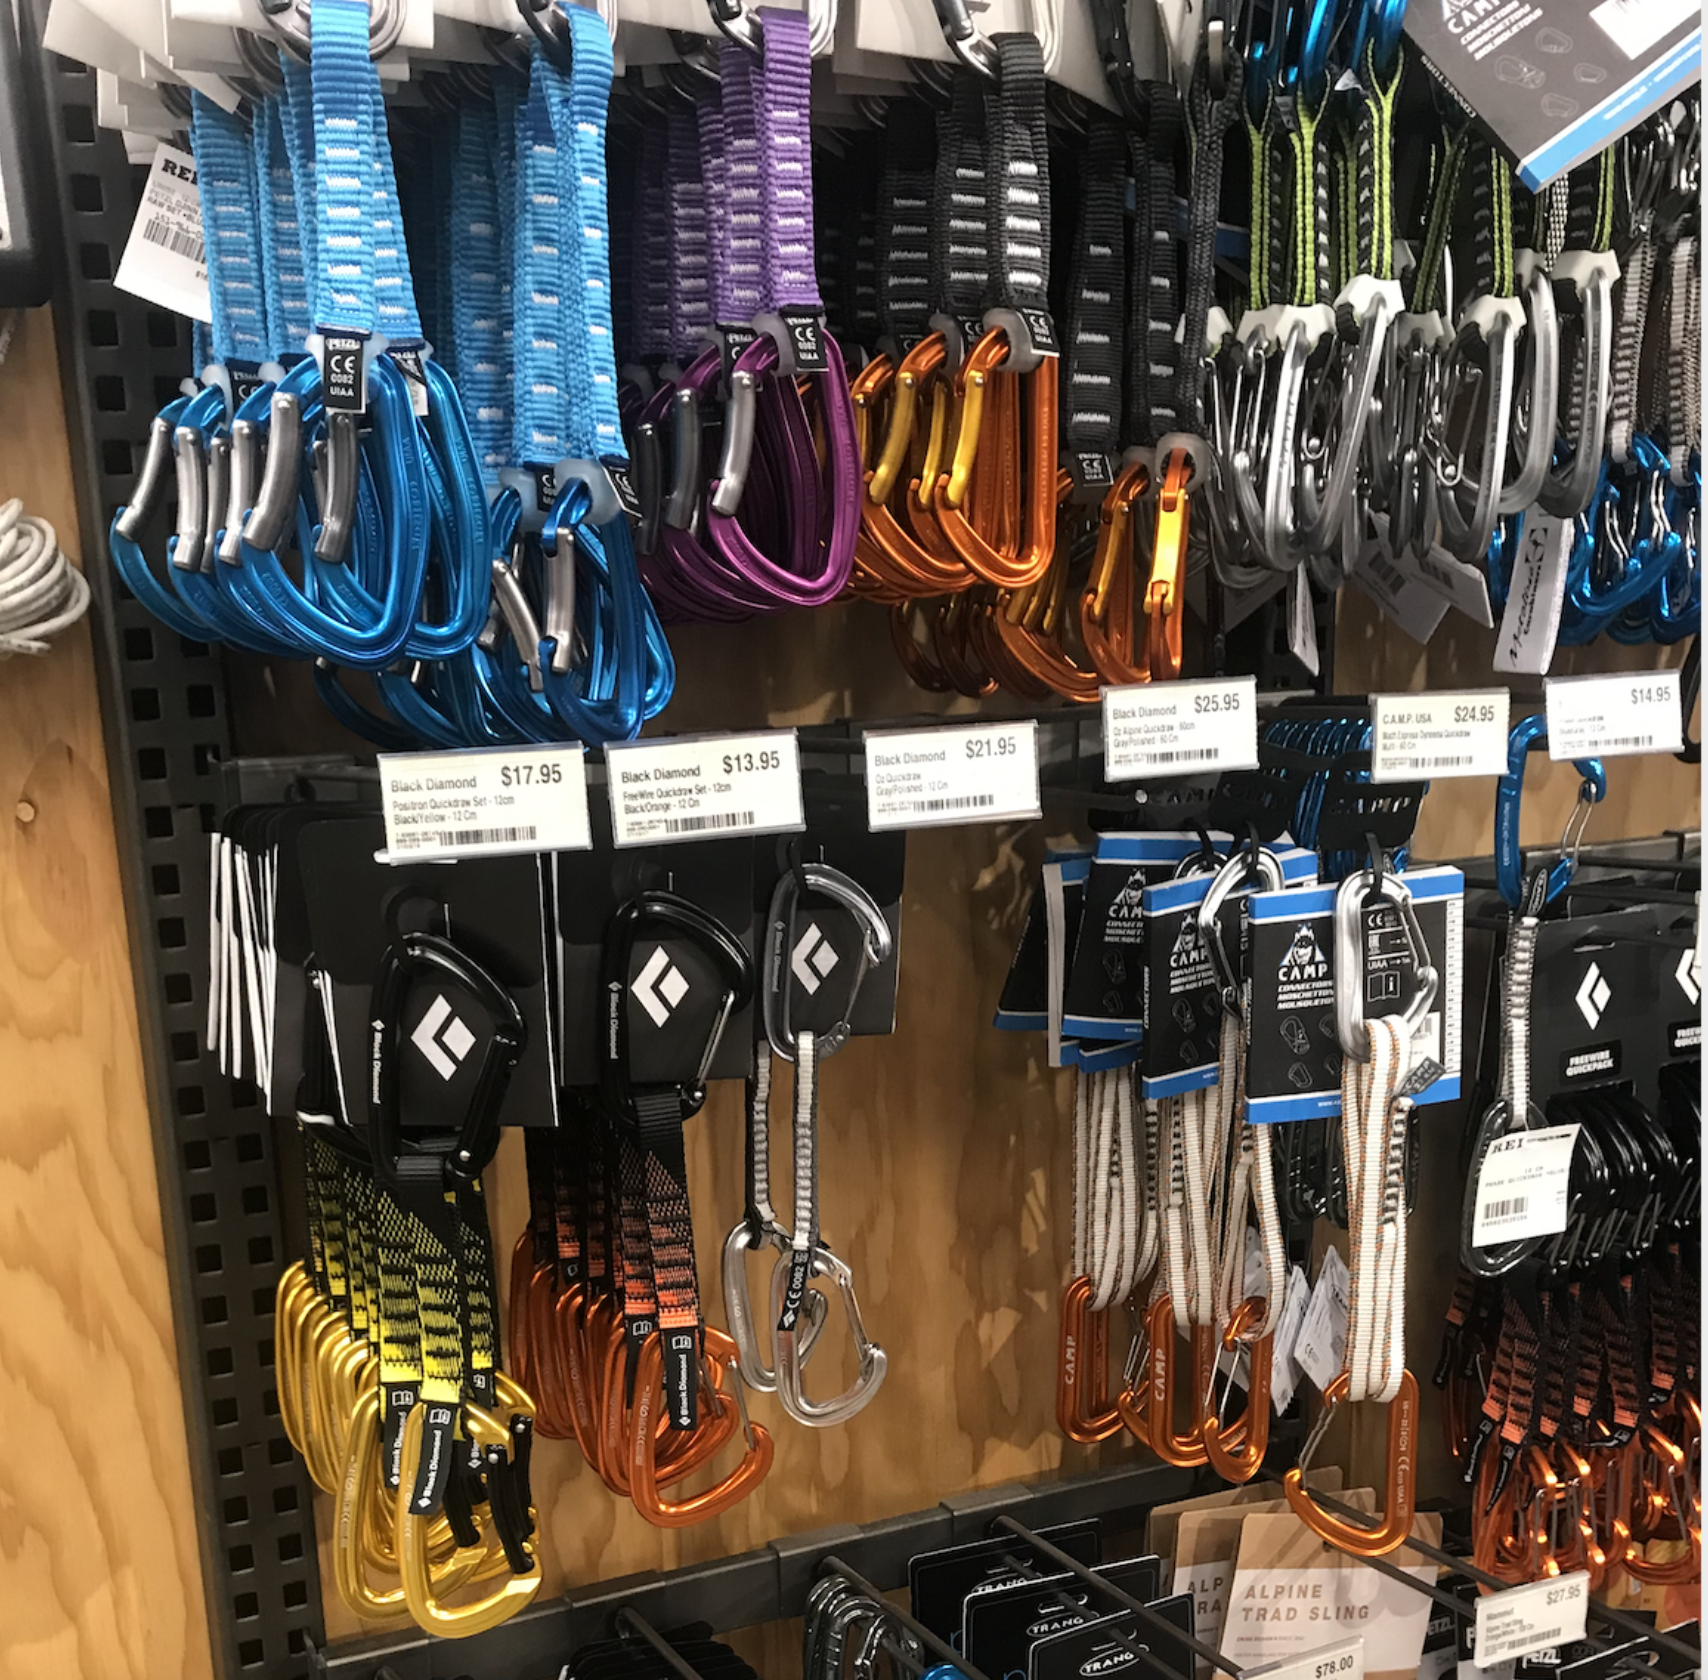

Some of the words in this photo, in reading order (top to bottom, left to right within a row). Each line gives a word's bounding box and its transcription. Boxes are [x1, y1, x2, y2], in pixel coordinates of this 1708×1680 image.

[330, 373, 354, 385] 0082
[329, 385, 354, 397] UIAA
[1631, 685, 1671, 705] $14.95
[1113, 707, 1136, 720] Black
[1138, 704, 1177, 718] Diamond
[1194, 692, 1240, 714] $25.95
[1415, 713, 1433, 724] USA
[1454, 705, 1495, 723] $24.95
[1144, 722, 1174, 734] Quickdraw
[1444, 729, 1471, 739] Quickdraw
[875, 755, 901, 767] Black
[903, 750, 946, 765] Diamond
[966, 736, 1016, 760] $21.95
[621, 770, 651, 784] Black
[654, 765, 701, 781] Diamond
[722, 750, 780, 775] $13.95
[391, 779, 424, 793] Black
[426, 776, 477, 791] Diamond
[501, 763, 562, 788] $17.95
[886, 771, 921, 784] Quickdraw
[623, 789, 654, 802] FreeWire
[656, 786, 693, 799] Quickdraw
[694, 783, 707, 795] Set
[713, 782, 732, 793] 12cm
[876, 784, 923, 798] Gray/Polished
[928, 781, 936, 792] 12
[393, 799, 428, 811] Positron
[430, 797, 471, 810] Quickdraw
[473, 796, 487, 807] Set
[494, 794, 515, 805] 12cm
[624, 802, 671, 815] Black/Orange
[678, 799, 687, 809] 12
[394, 811, 446, 825] Black/Yellow
[453, 811, 462, 822] 12
[464, 810, 477, 821] Cm
[1368, 913, 1382, 927] CE
[773, 931, 783, 955] Black
[1278, 963, 1328, 981] CAMP
[1368, 959, 1388, 970] UIAA
[610, 992, 619, 1018] Black
[373, 1031, 383, 1059] Black
[610, 1018, 619, 1060] Diamond
[1565, 1058, 1614, 1077] QUICKPACK
[1569, 1049, 1611, 1066] FREEWIRE
[372, 1060, 382, 1104] Diamond
[1491, 1137, 1525, 1155] REI
[792, 1266, 804, 1289] 0082
[786, 1291, 802, 1308] CE
[1065, 1335, 1076, 1385] CAMP
[678, 1354, 688, 1391] Diamond
[1154, 1348, 1166, 1401] CAMP
[678, 1391, 689, 1415] Black
[429, 1430, 442, 1471] Diamond
[391, 1449, 401, 1475] Black
[422, 1471, 437, 1497] Black
[1188, 1576, 1224, 1594] ALP
[1244, 1584, 1323, 1599] ALPINE
[1546, 1584, 1581, 1606] $27.95
[1242, 1607, 1298, 1622] TRAD
[1308, 1605, 1370, 1621] SLING
[1315, 1655, 1354, 1679] $78.00
